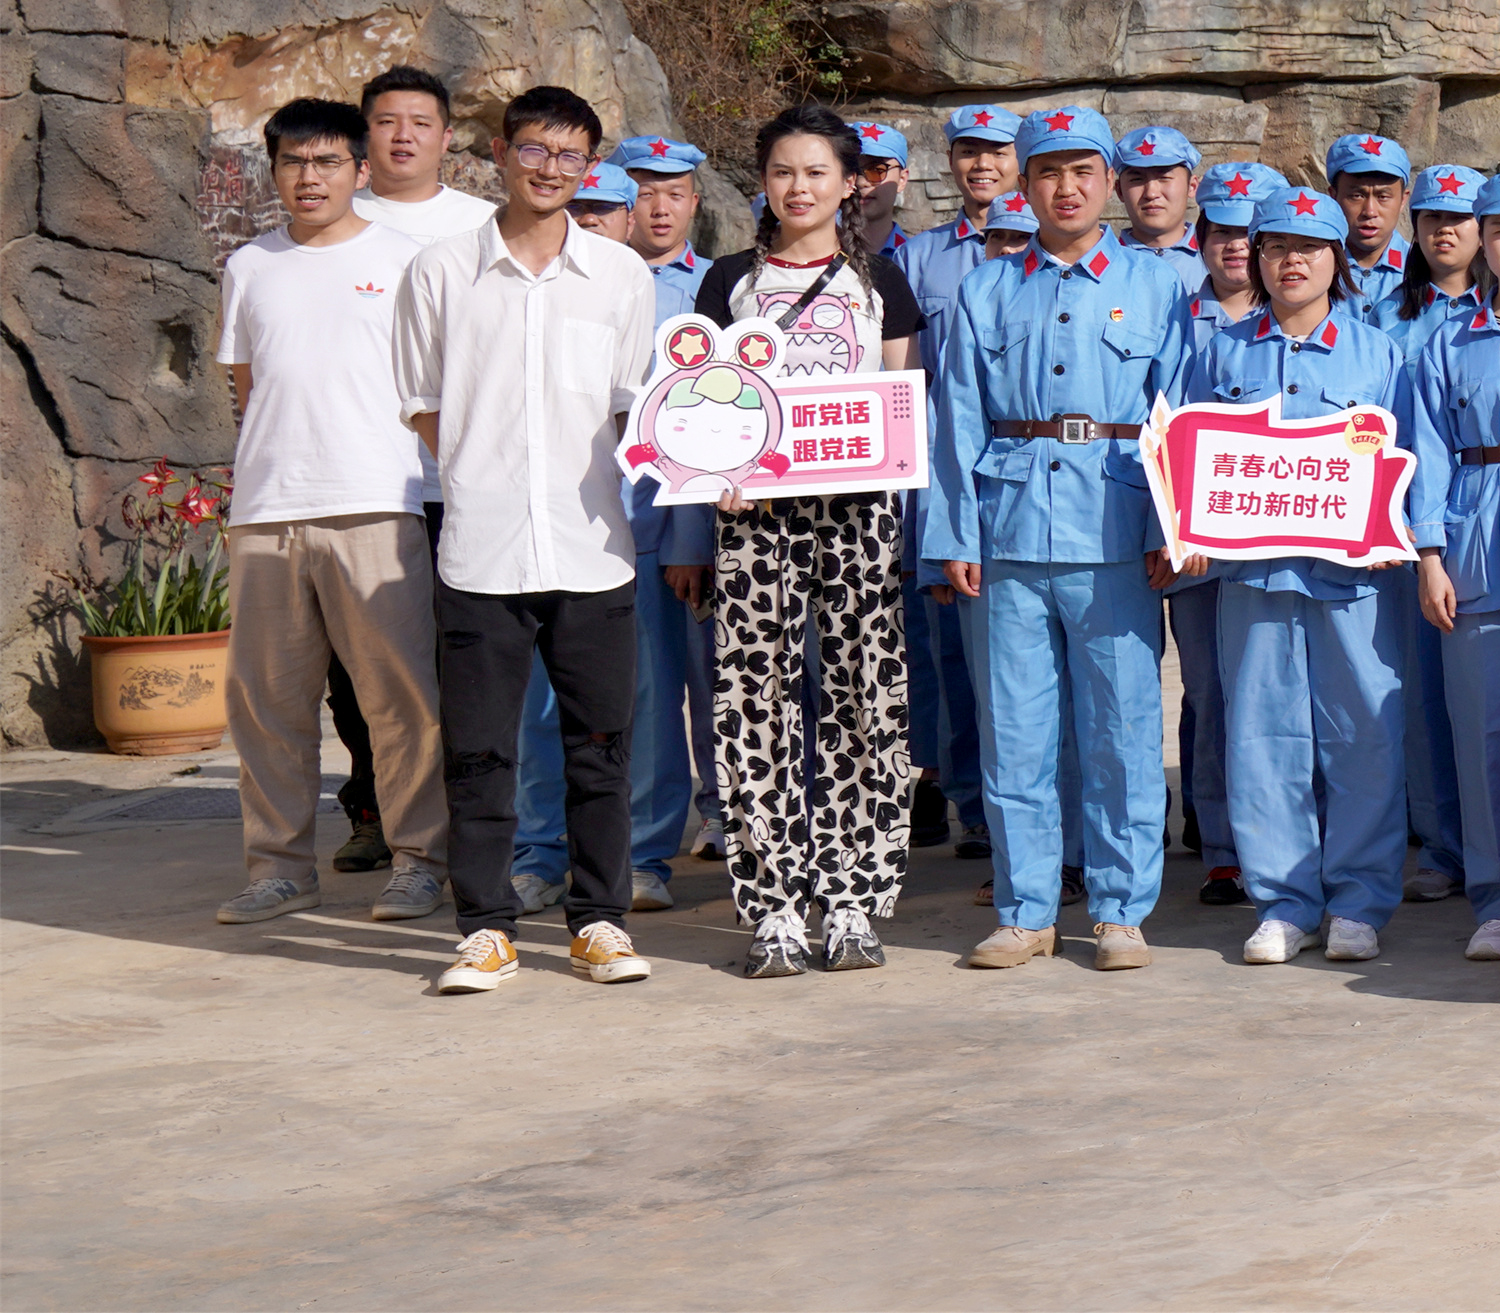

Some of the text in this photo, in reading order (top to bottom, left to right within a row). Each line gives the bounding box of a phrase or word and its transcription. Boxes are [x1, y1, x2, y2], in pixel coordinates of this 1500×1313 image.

[792, 400, 870, 428] 听党话
[793, 436, 871, 463] 跟党走
[1212, 452, 1350, 482] 青春心向党
[1206, 489, 1347, 520] 建功新时代
